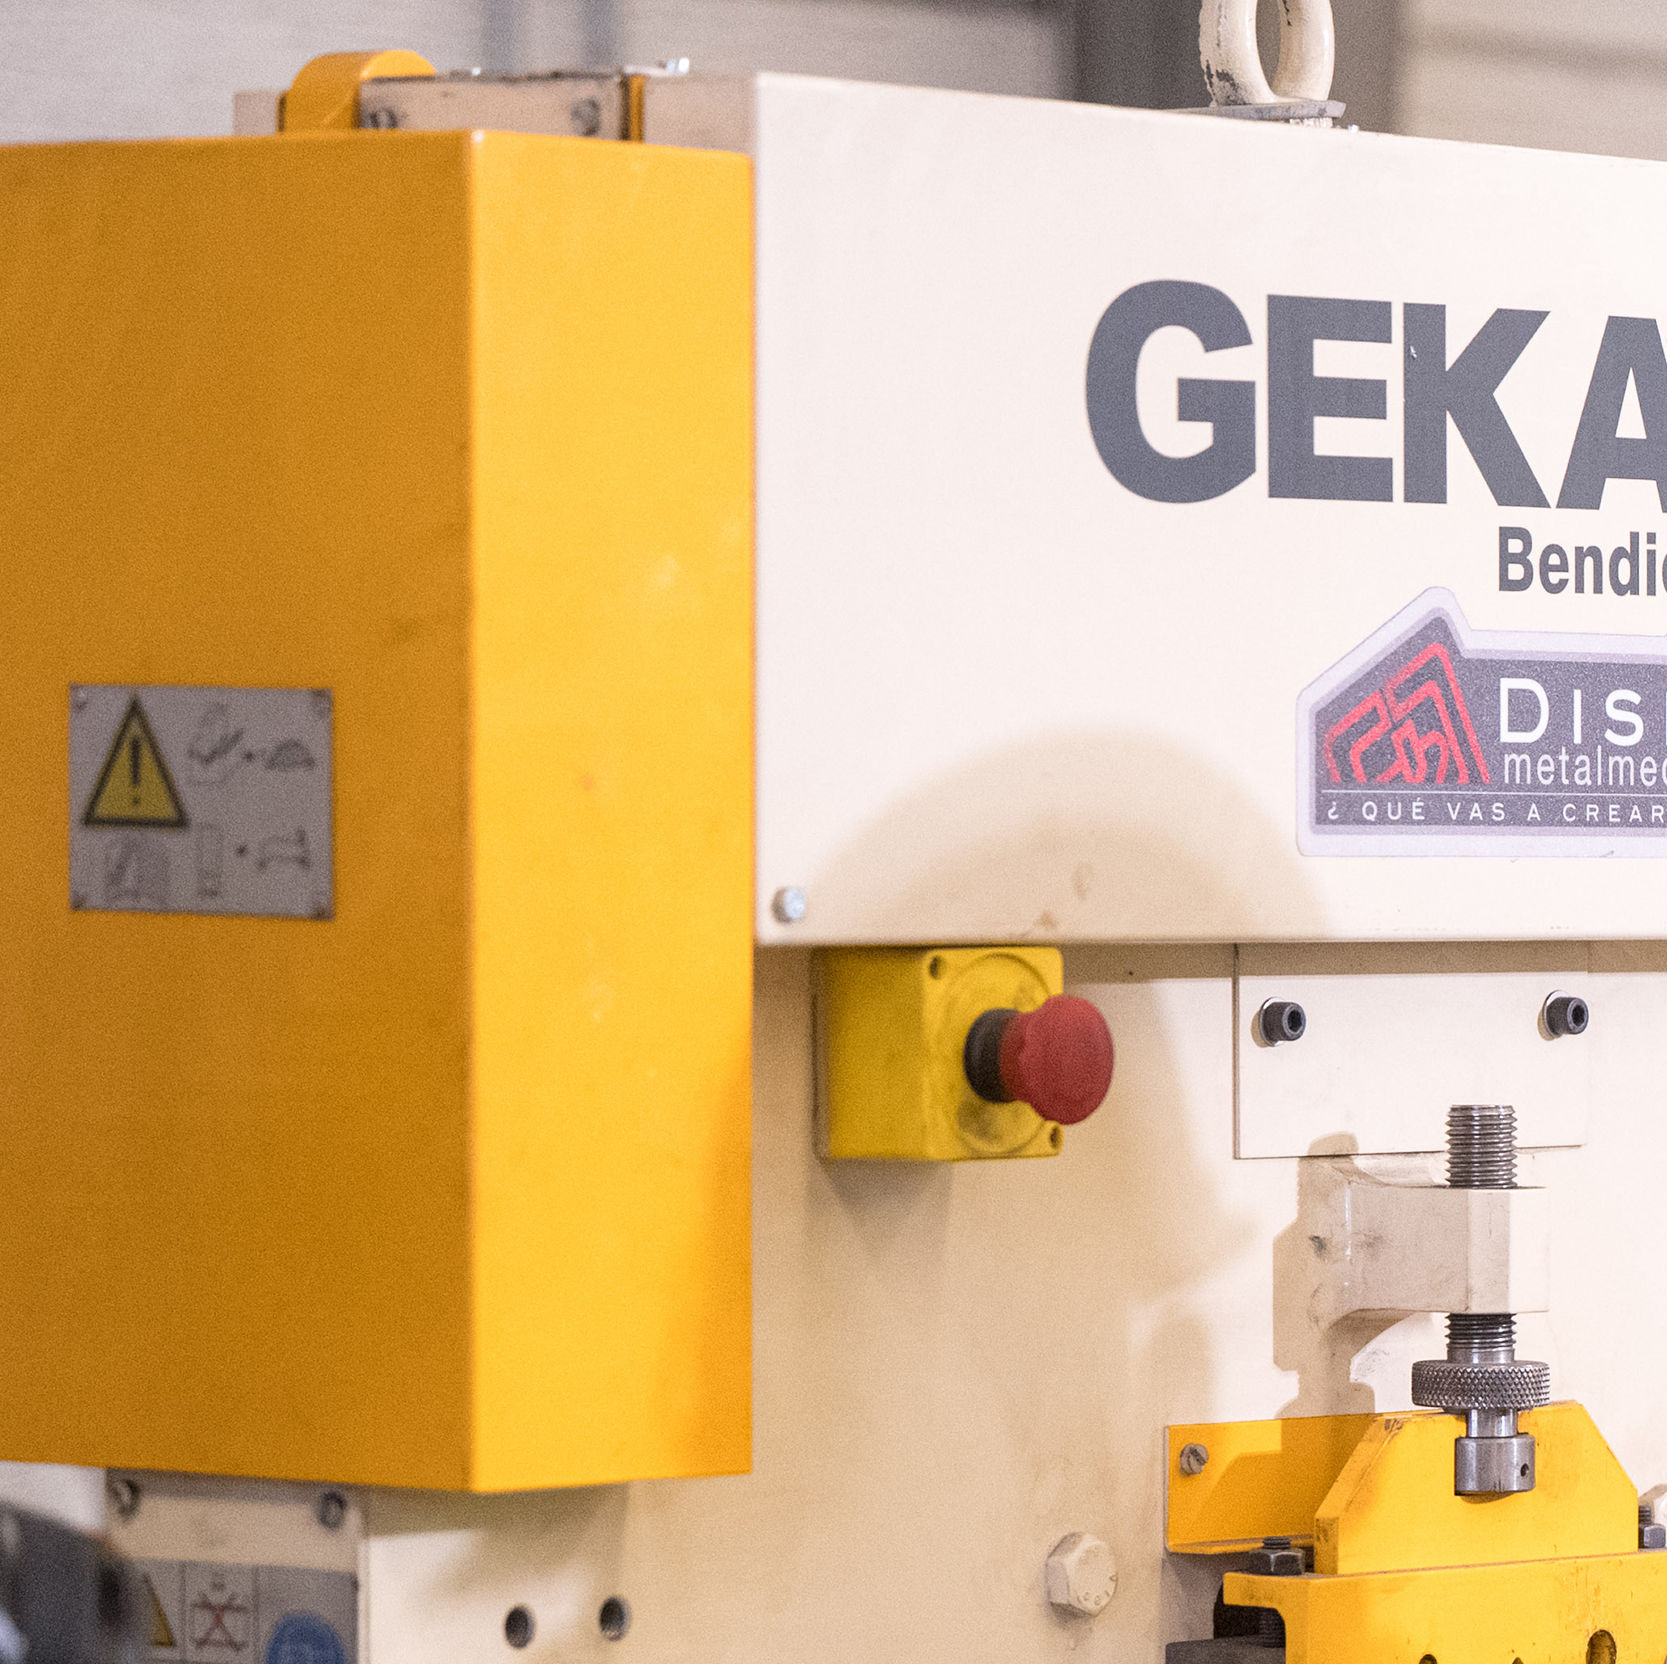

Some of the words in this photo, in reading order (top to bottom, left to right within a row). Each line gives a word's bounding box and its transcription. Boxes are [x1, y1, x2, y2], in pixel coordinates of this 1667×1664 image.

[1446, 802, 1506, 822] VAS
[1526, 803, 1541, 822] A
[1562, 803, 1665, 824] CREAR
